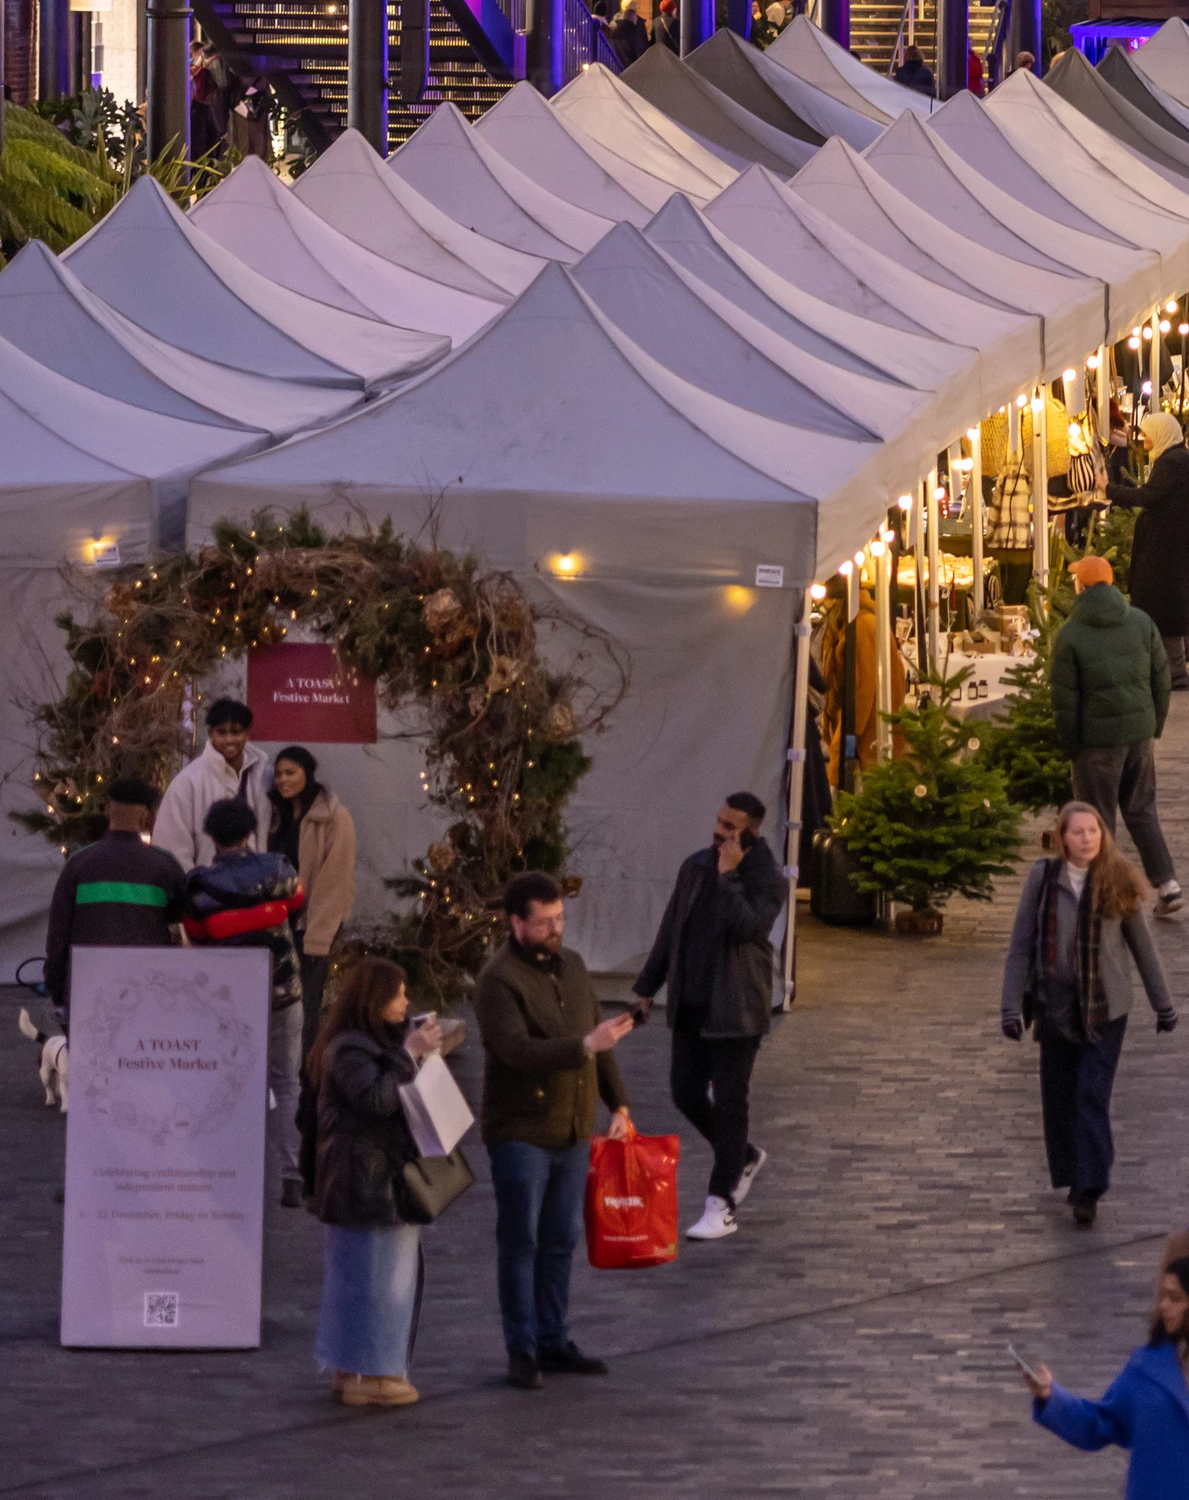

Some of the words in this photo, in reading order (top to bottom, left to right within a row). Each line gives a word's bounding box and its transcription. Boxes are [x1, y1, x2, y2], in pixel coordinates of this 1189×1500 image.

[286, 678, 294, 689] A
[273, 691, 310, 704] Festive
[312, 692, 350, 705] Market
[136, 1039, 146, 1051] A
[149, 1038, 202, 1051] TOAST
[118, 1057, 165, 1070] Festive
[170, 1057, 218, 1071] Market
